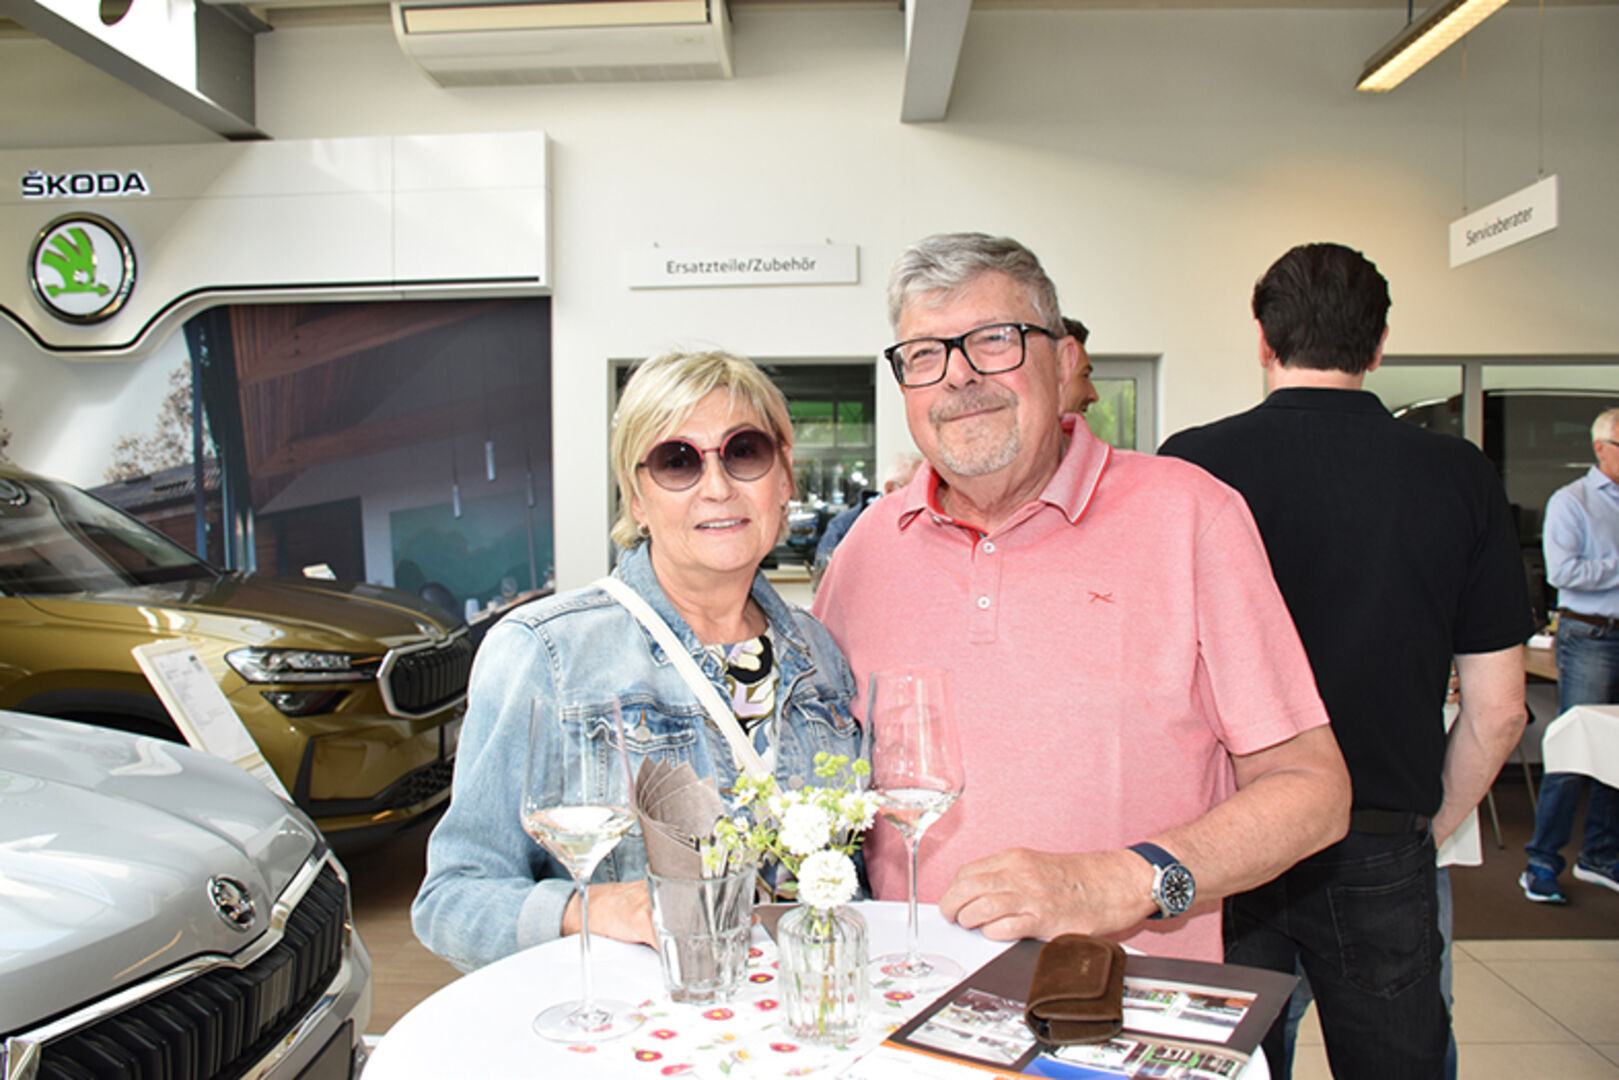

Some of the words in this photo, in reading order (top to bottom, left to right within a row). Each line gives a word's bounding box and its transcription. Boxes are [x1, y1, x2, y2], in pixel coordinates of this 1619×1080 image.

[21, 170, 147, 197] ŠKODA
[1466, 207, 1534, 247] Serviceberater
[666, 257, 816, 274] Ersatzteile/Zubehör
